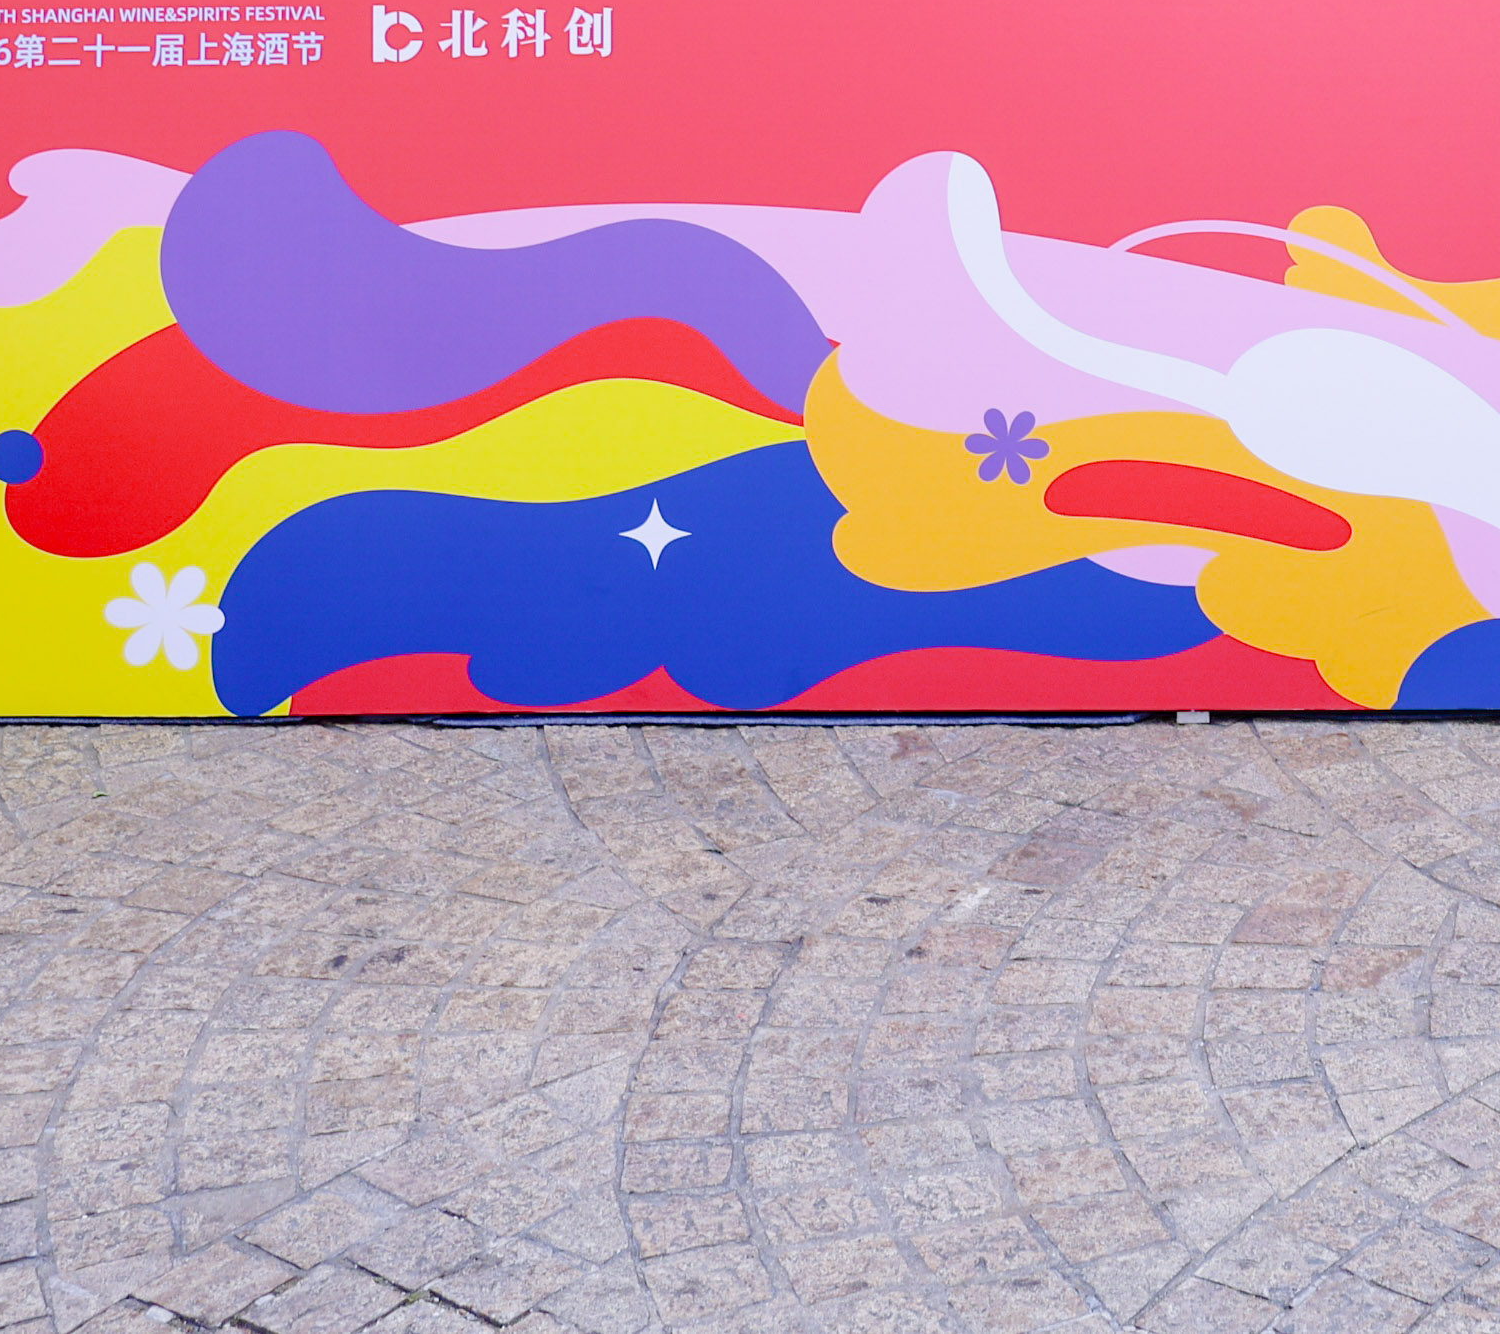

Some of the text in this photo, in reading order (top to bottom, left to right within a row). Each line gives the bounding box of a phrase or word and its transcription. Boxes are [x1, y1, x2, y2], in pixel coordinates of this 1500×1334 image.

[21, 7, 115, 24] SHANGHAI
[119, 6, 241, 23] WINE&SPIRITS
[245, 5, 325, 22] FESTIVAL
[438, 6, 615, 60] 北科创
